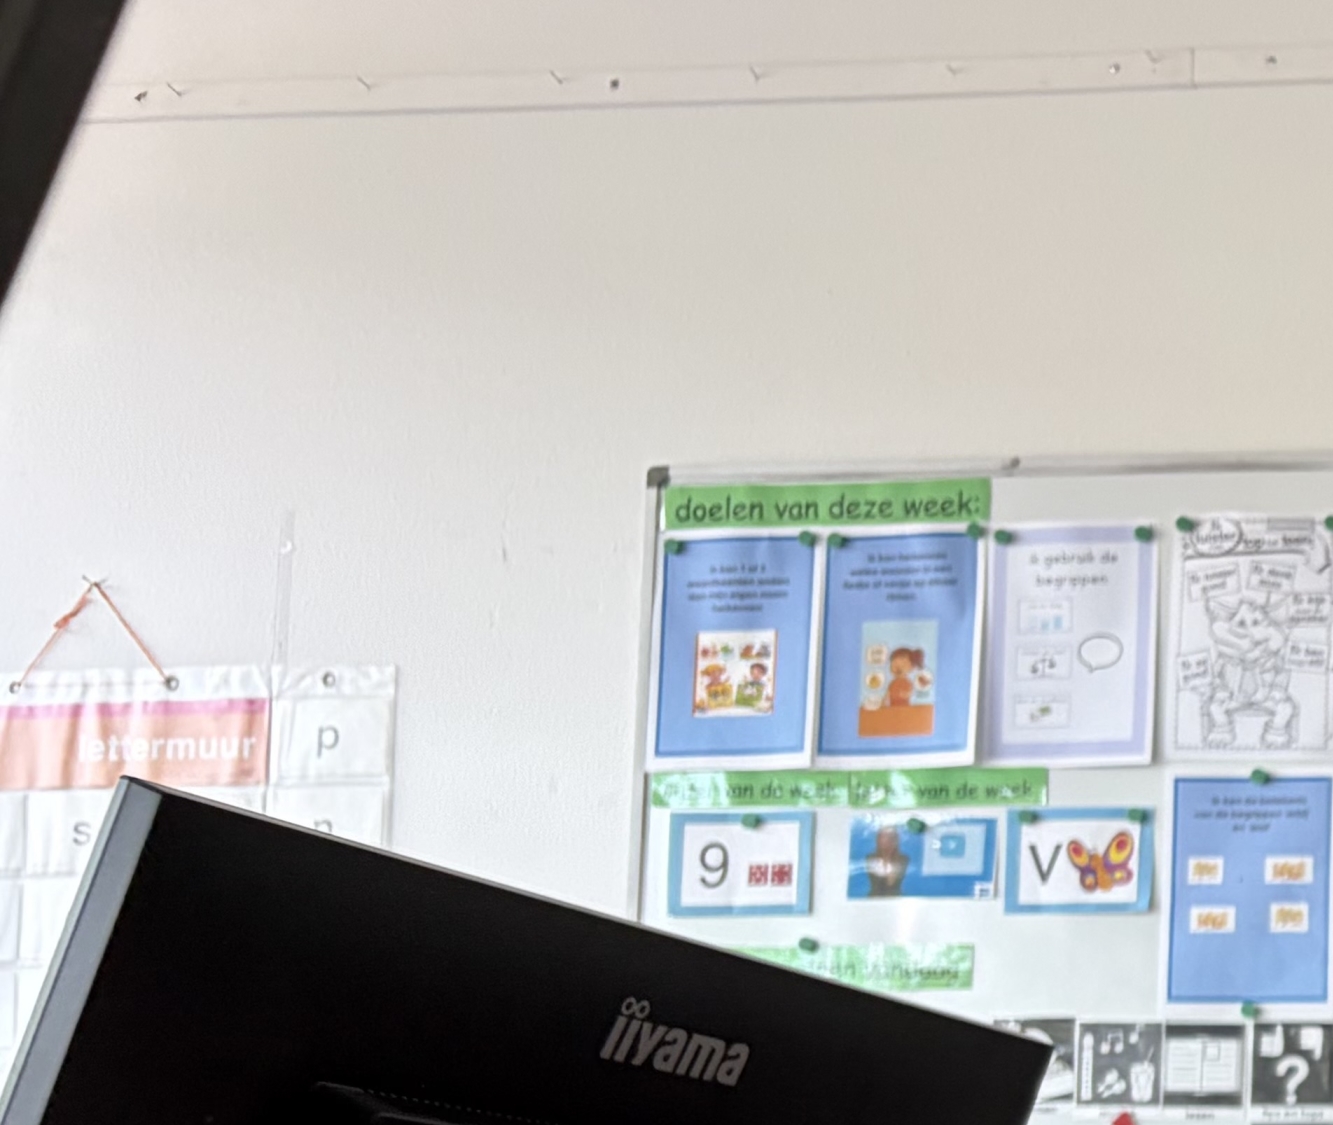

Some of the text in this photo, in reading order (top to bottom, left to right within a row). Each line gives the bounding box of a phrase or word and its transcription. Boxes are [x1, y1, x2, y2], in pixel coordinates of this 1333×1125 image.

[676, 488, 981, 523] doelen van deze week:
[78, 733, 257, 762] lettermuur
[316, 723, 341, 758] p
[72, 821, 92, 847] s
[699, 841, 730, 888] 9
[599, 996, 750, 1088] iiyama
